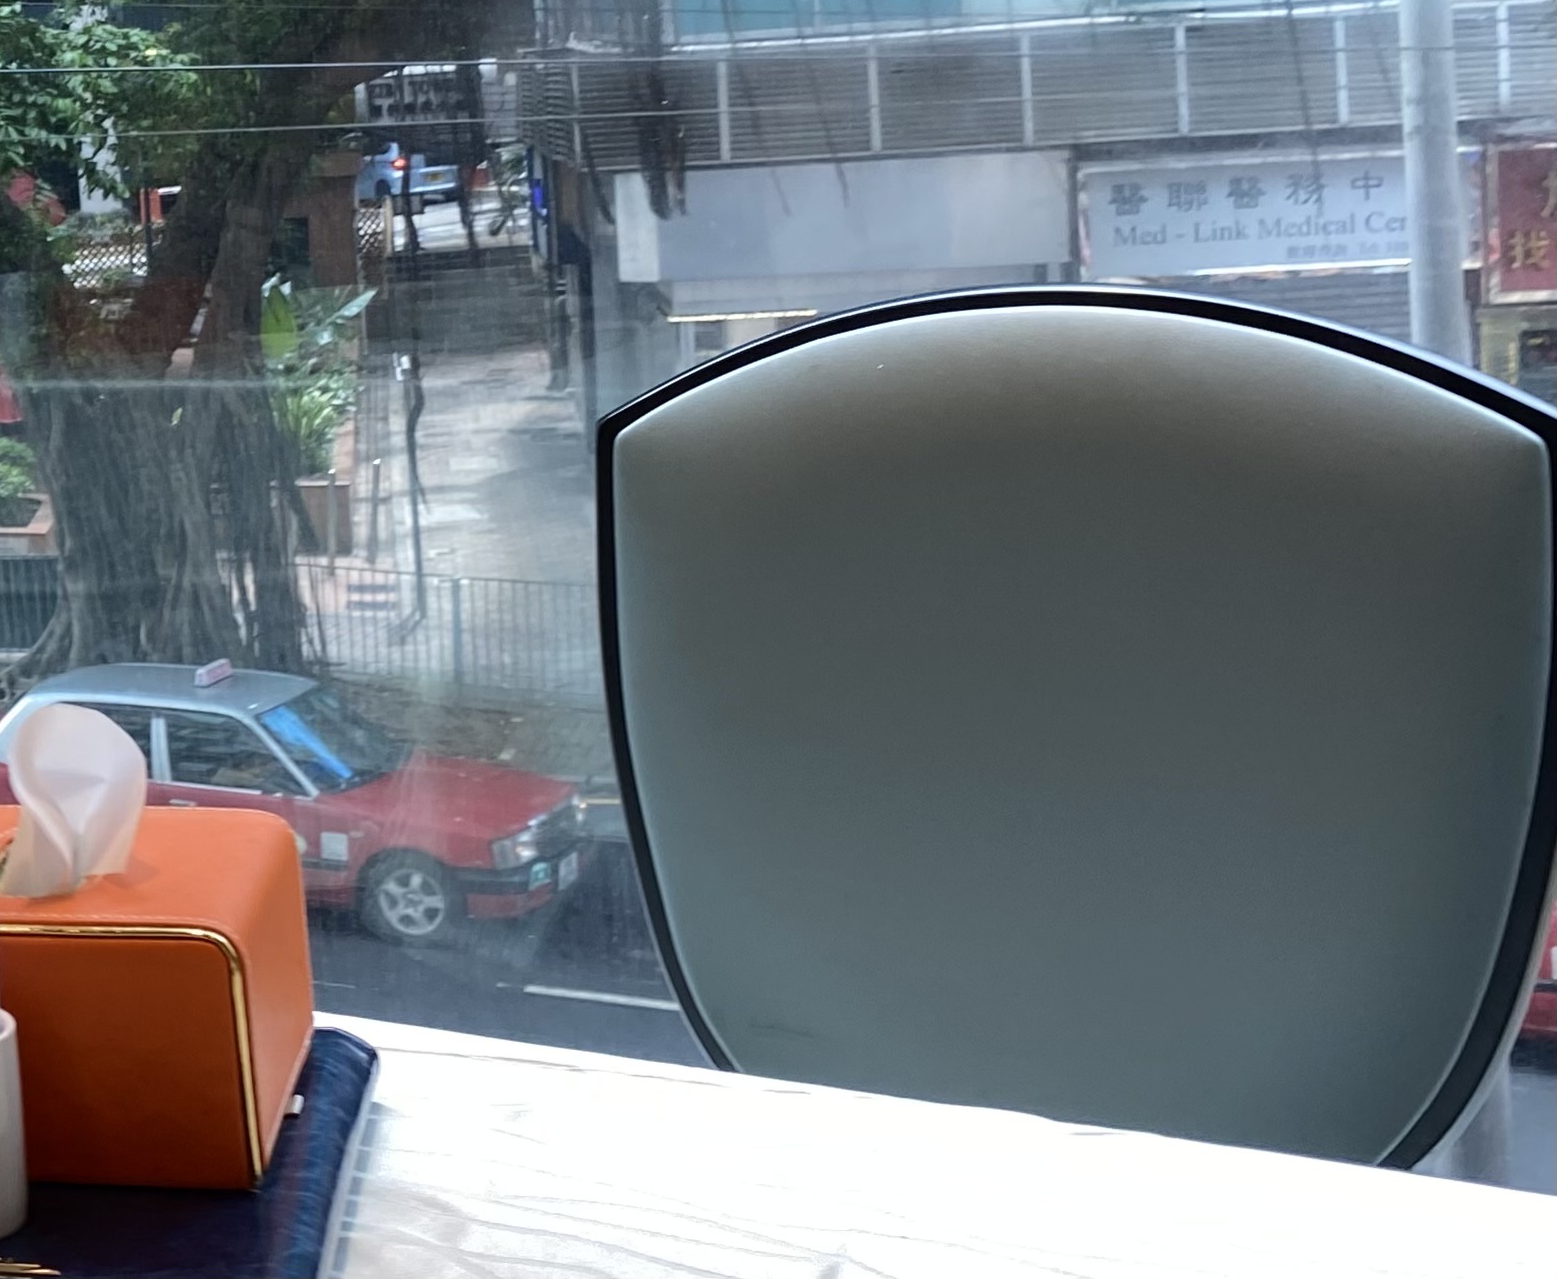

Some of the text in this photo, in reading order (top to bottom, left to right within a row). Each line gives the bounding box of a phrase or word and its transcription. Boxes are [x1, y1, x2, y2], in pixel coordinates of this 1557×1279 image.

[1113, 223, 1167, 247] Med
[1194, 218, 1250, 244] Link
[1257, 211, 1356, 240] Medical
